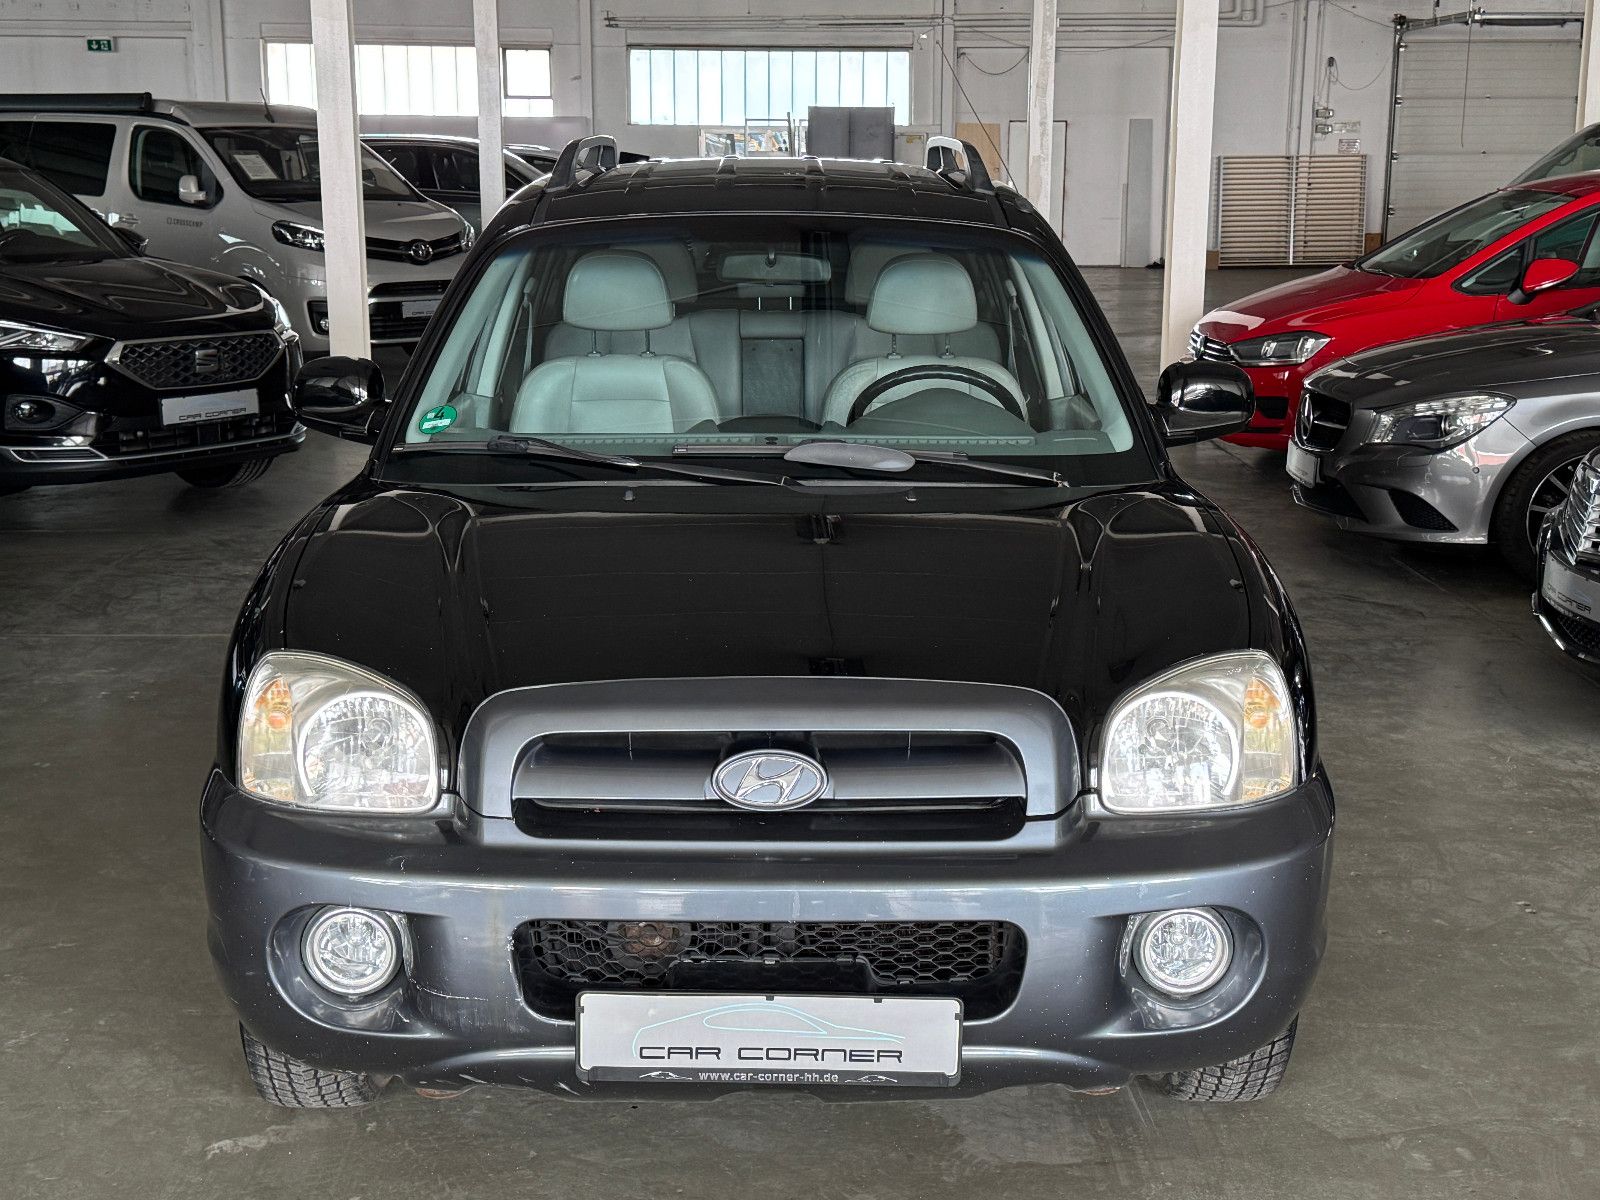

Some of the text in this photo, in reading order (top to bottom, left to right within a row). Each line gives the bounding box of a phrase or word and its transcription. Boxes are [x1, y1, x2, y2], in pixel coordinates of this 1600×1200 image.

[179, 407, 247, 421] CAR CORNER
[433, 406, 445, 420] 4
[639, 1046, 903, 1063] CAR CORNER
[698, 1071, 839, 1083] www.car-corner-hh.de
